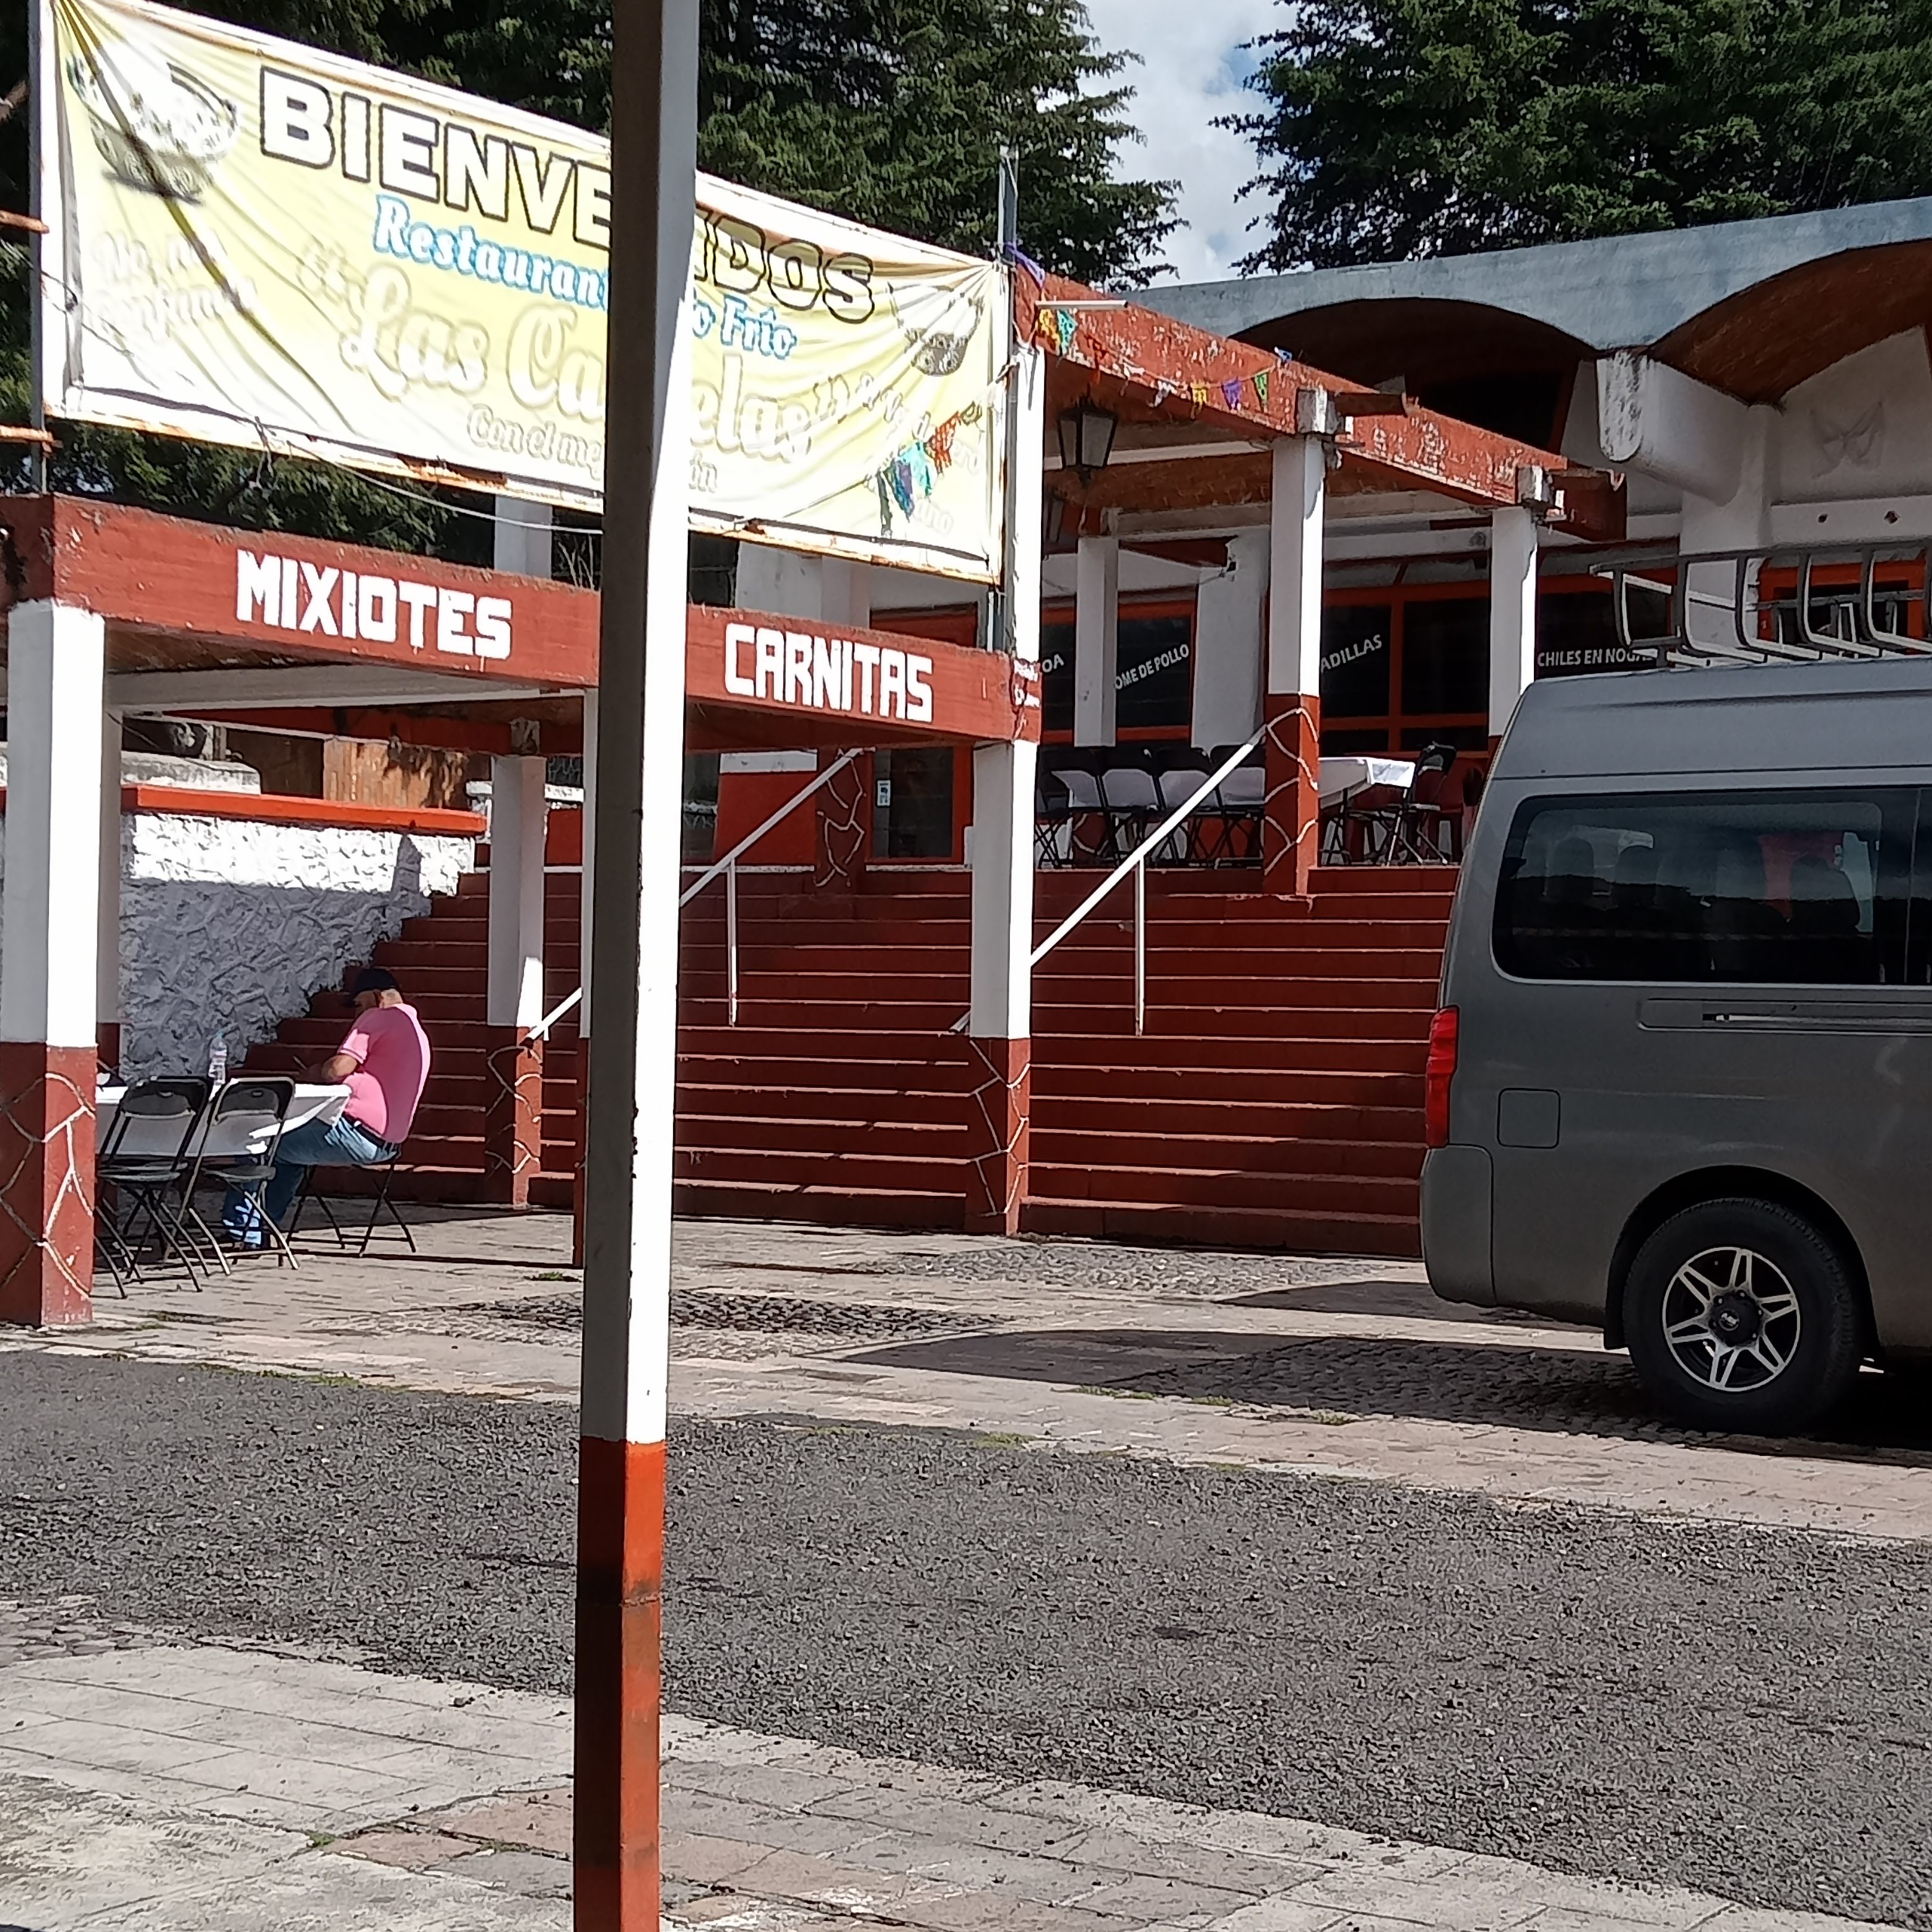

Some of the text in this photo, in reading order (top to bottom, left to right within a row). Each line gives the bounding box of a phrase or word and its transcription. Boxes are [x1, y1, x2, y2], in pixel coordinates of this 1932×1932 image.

[259, 66, 875, 324] BIENVEIDOS
[236, 548, 513, 660] MIXIOTES
[724, 622, 933, 723] CARNITAS
[1139, 660, 1155, 679] DE
[1154, 643, 1190, 672] POLLO
[1320, 633, 1383, 674] ADILLAS
[1537, 650, 1582, 667] CHILES
[1584, 649, 1603, 664] EN
